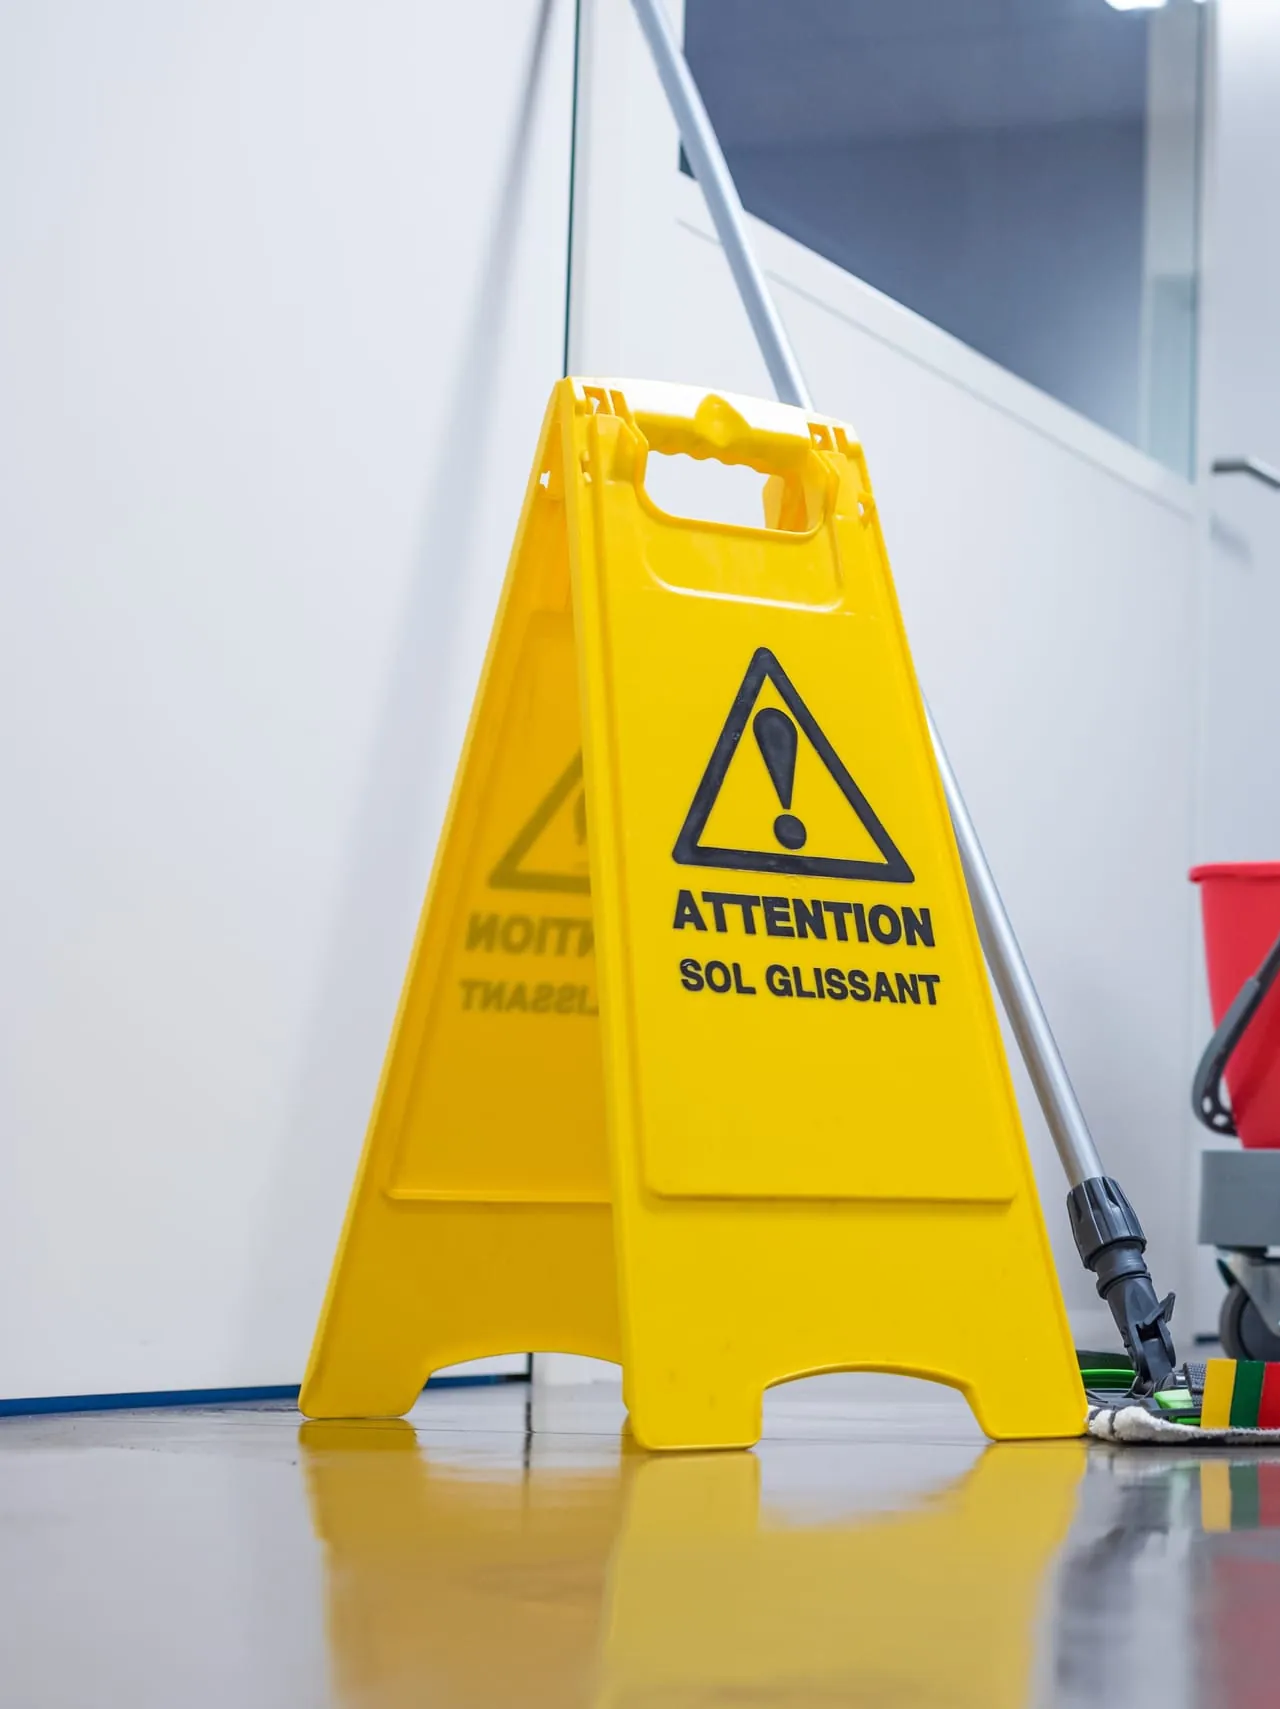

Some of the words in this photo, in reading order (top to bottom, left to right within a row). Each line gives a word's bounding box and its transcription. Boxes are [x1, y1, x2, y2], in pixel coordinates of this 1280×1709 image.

[673, 889, 936, 947] ATTENTION
[680, 958, 757, 995] SOL
[765, 964, 940, 1005] GLISSANT
